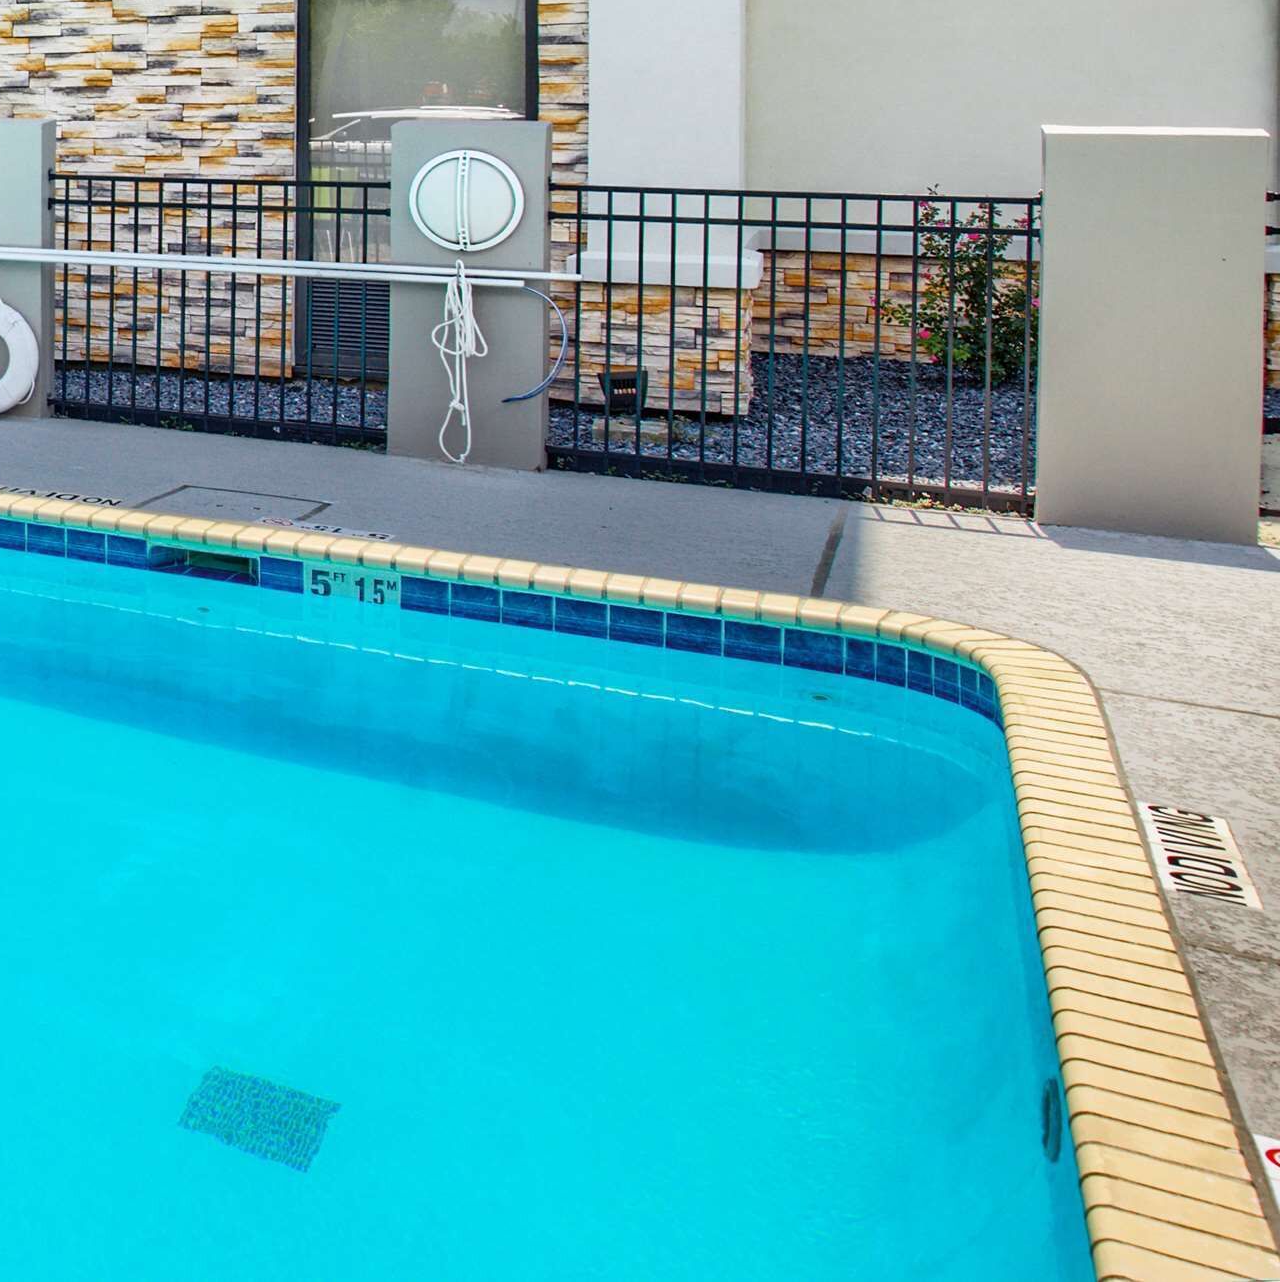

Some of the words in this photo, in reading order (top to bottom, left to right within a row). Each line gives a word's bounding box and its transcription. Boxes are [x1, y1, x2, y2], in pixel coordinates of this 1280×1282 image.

[82, 497, 123, 506] NO
[310, 568, 332, 597] 5
[333, 571, 347, 583] FT
[386, 580, 397, 592] M
[1147, 805, 1238, 878] DIVING
[1168, 871, 1248, 907] NO
